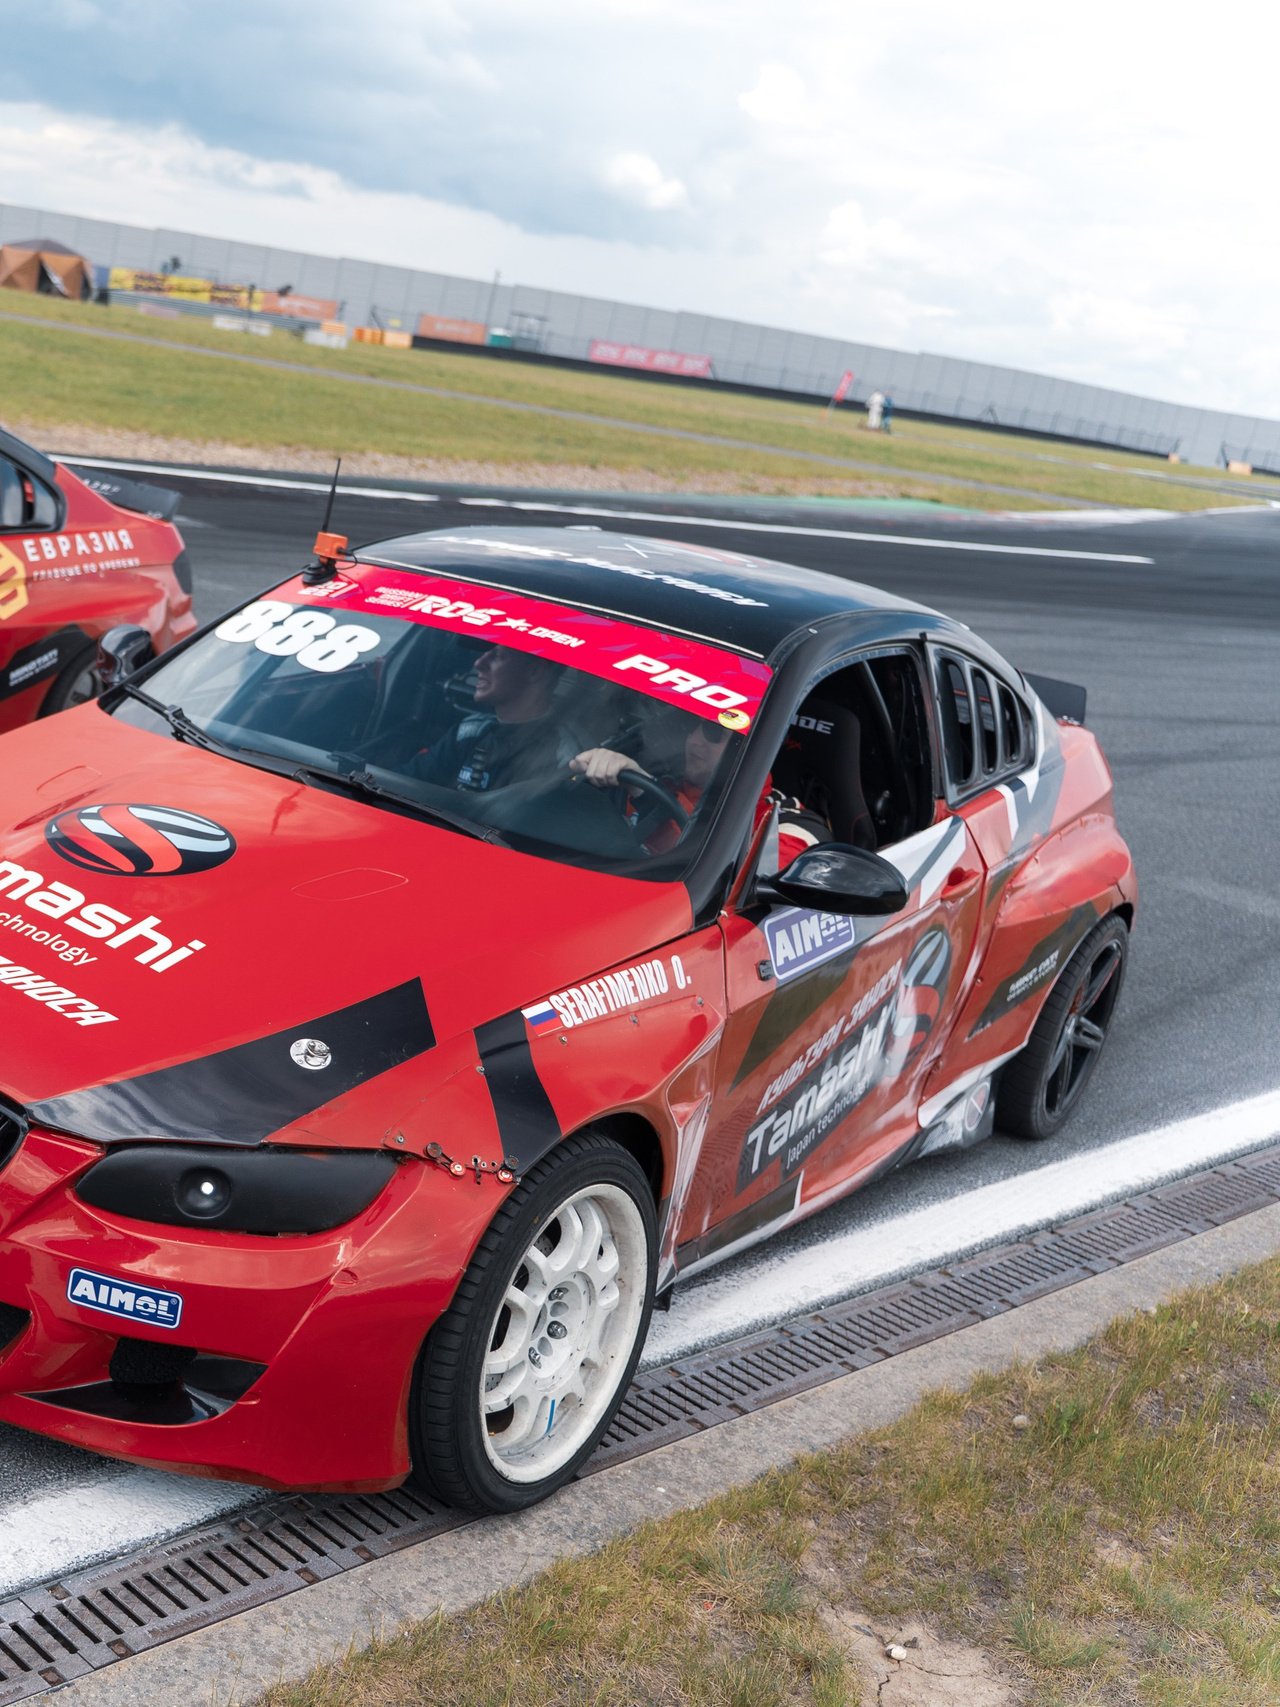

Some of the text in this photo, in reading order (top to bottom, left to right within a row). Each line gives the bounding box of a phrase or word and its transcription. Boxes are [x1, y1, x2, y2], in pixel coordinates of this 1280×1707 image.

[22, 529, 134, 562] ЕВРАЗИЯ
[214, 600, 381, 673] 888
[409, 595, 586, 648] RDS OPEN
[612, 654, 749, 709] PRO
[775, 913, 851, 967] AIMOL
[549, 955, 692, 1028] SERAFIMENKO O.
[756, 957, 903, 1116] КУЛЬТУРА ЗАНОСА
[747, 1005, 889, 1174] Tamashi
[786, 1127, 816, 1170] Japan
[72, 1278, 175, 1322] AIMOL
